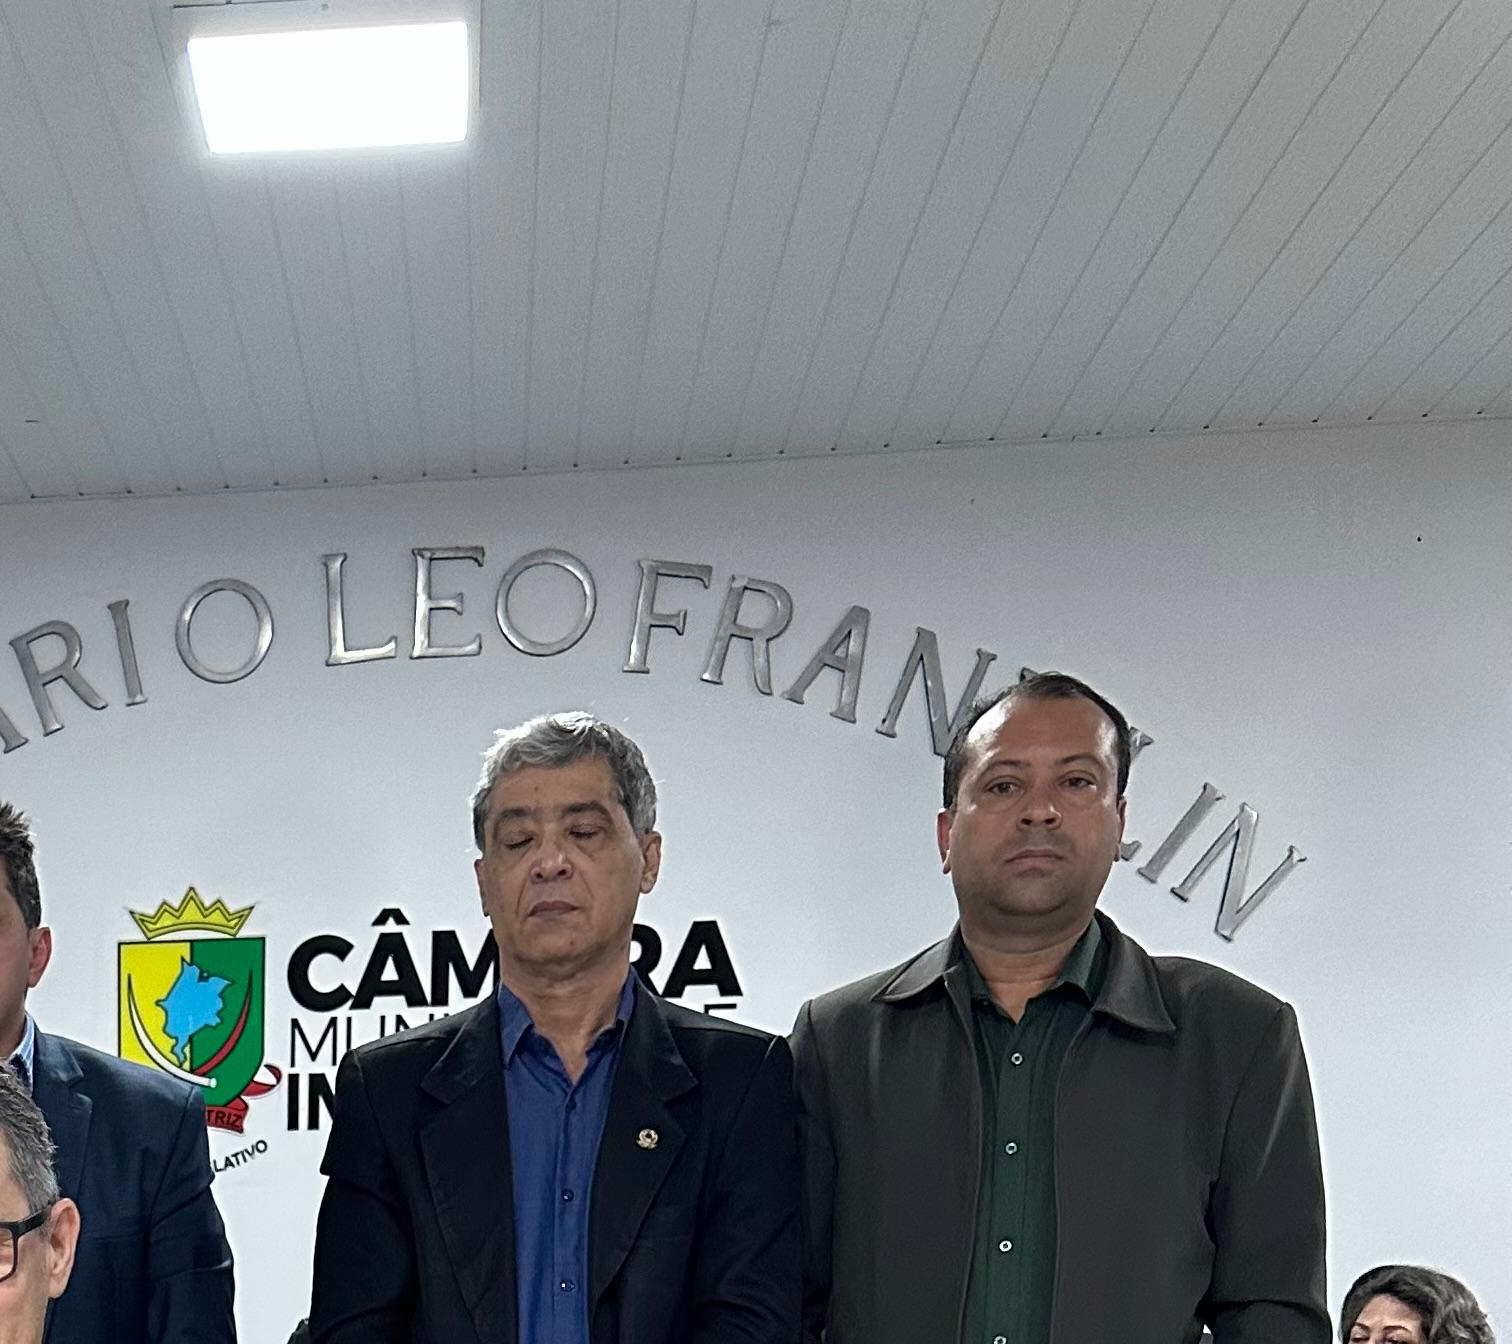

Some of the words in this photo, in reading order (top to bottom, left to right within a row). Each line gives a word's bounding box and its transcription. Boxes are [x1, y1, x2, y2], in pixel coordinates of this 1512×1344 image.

[321, 545, 597, 667] LEO
[622, 558, 1307, 943] FRANIN
[286, 907, 744, 1013] CÂMRA
[212, 1139, 268, 1173] LATIVO
